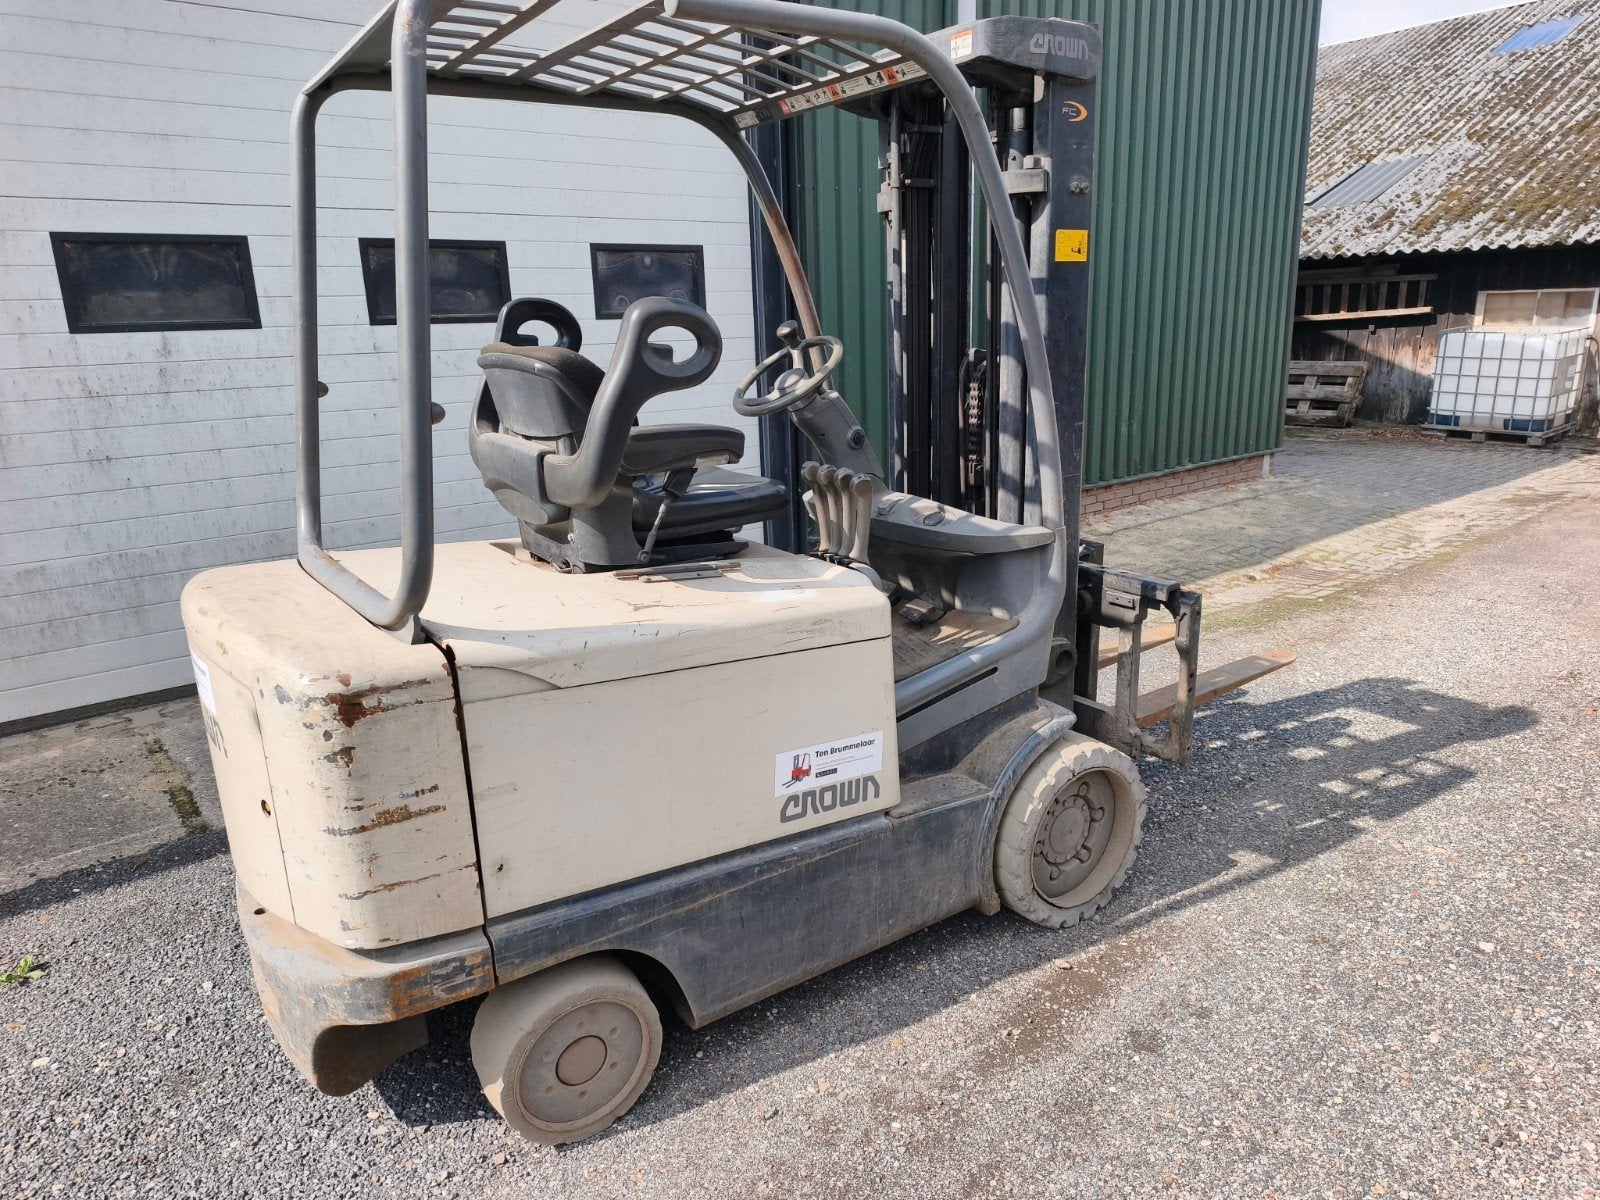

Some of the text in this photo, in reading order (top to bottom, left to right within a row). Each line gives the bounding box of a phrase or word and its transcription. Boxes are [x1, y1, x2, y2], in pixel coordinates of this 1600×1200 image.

[1029, 33, 1089, 60] CROWN
[1062, 107, 1077, 116] FC
[815, 739, 876, 758] Ten Brummelaar
[780, 775, 880, 823] CROWN
